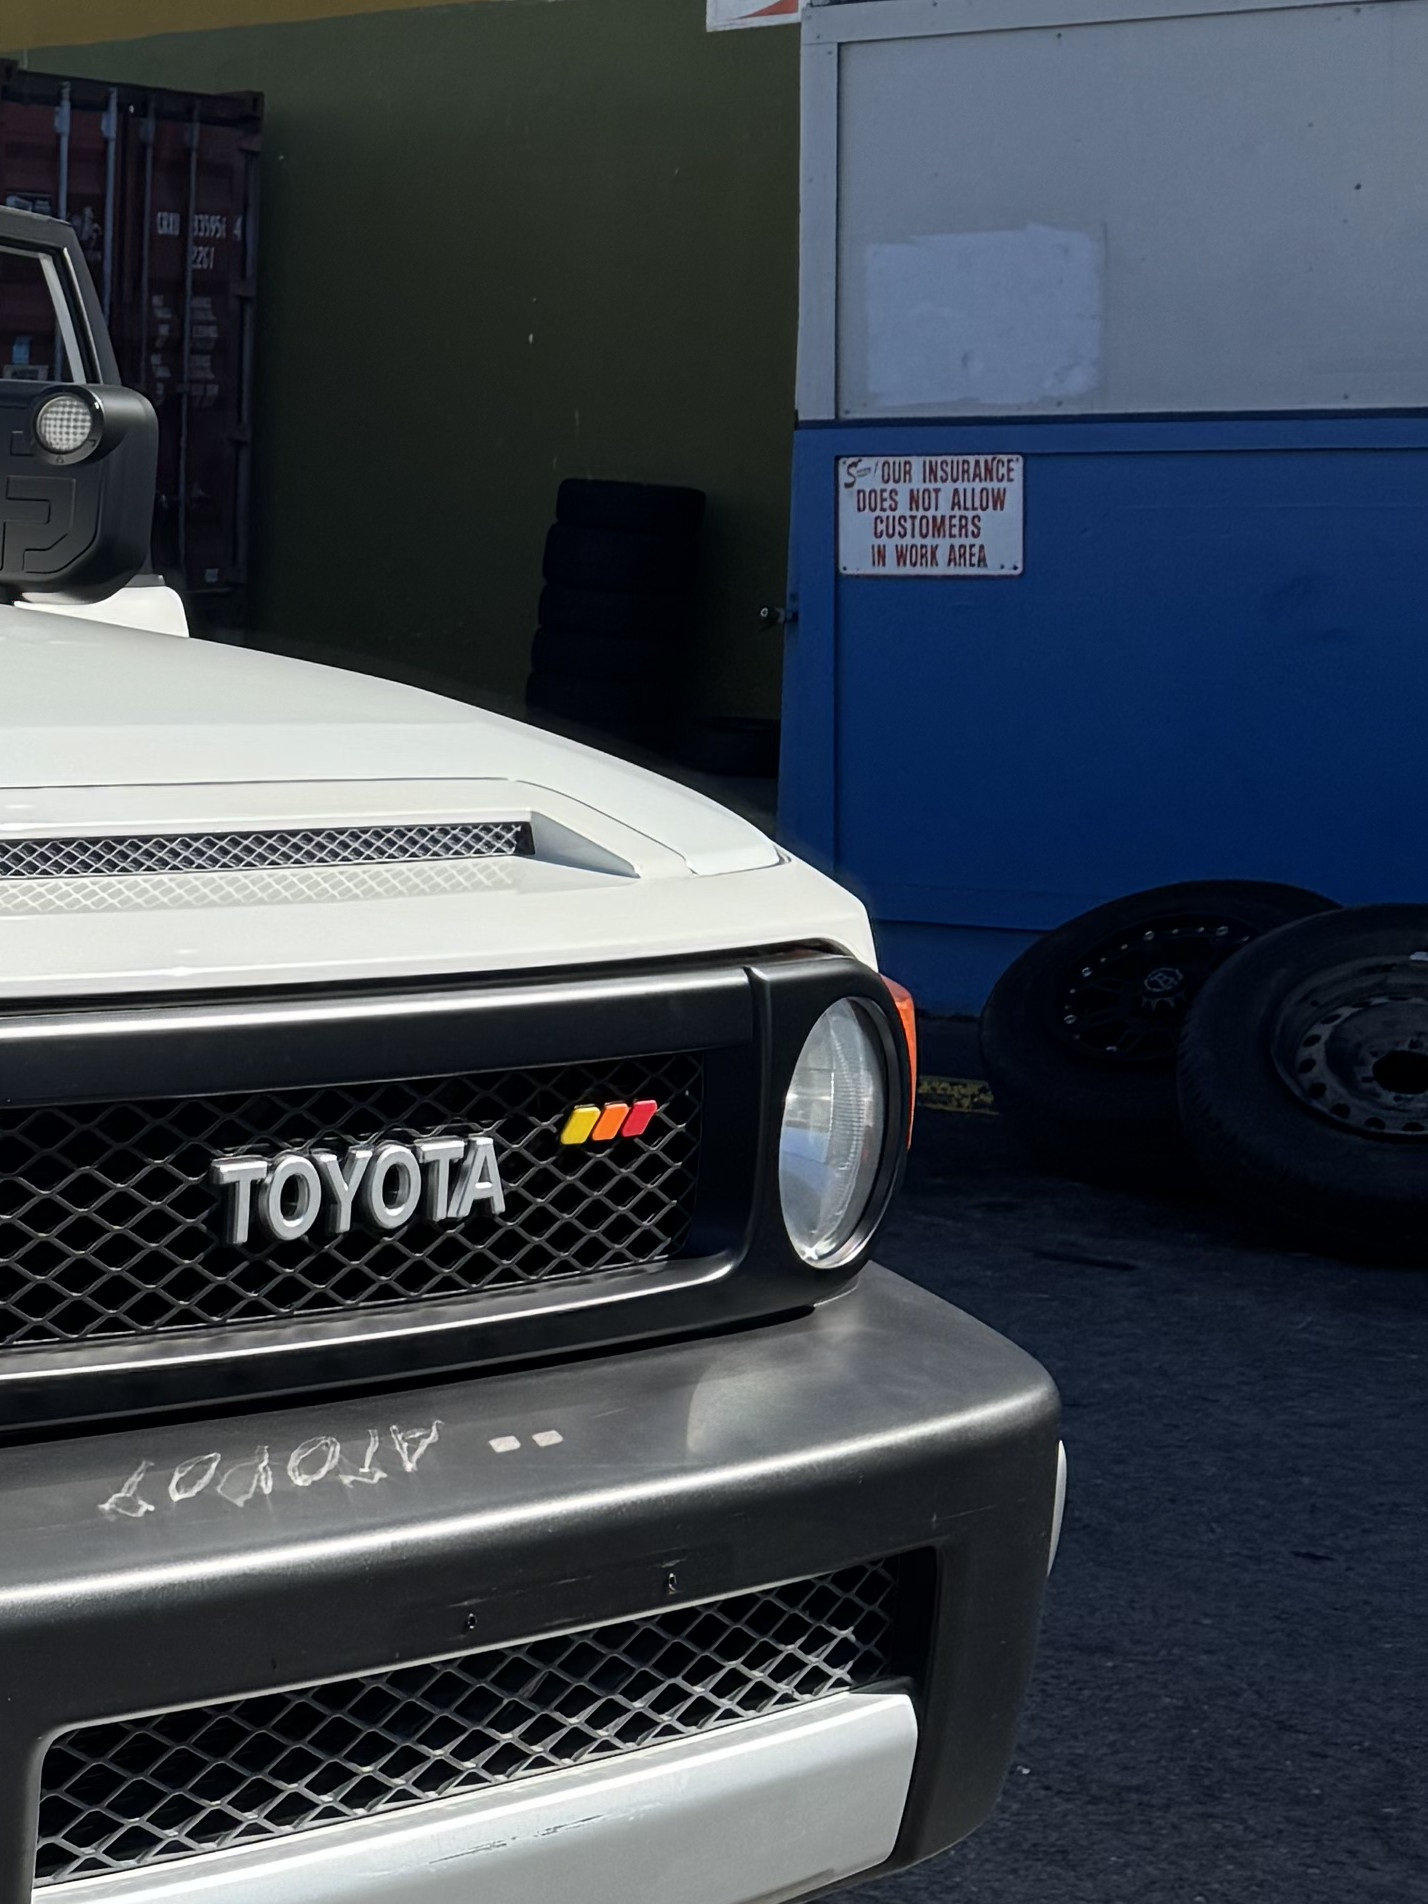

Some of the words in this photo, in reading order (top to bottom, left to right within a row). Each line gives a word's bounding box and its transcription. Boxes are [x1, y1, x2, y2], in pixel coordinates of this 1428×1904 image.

[881, 460, 912, 483] OUR
[923, 458, 1015, 483] INSURANCE
[857, 489, 898, 512] DOES
[909, 488, 941, 511] NOT
[951, 487, 1006, 511] ALLOW
[874, 514, 981, 539] CUSTOMERS
[871, 544, 886, 567] IN
[895, 544, 939, 567] WORK
[947, 544, 988, 568] AREA
[211, 1136, 506, 1245] TOYOTA
